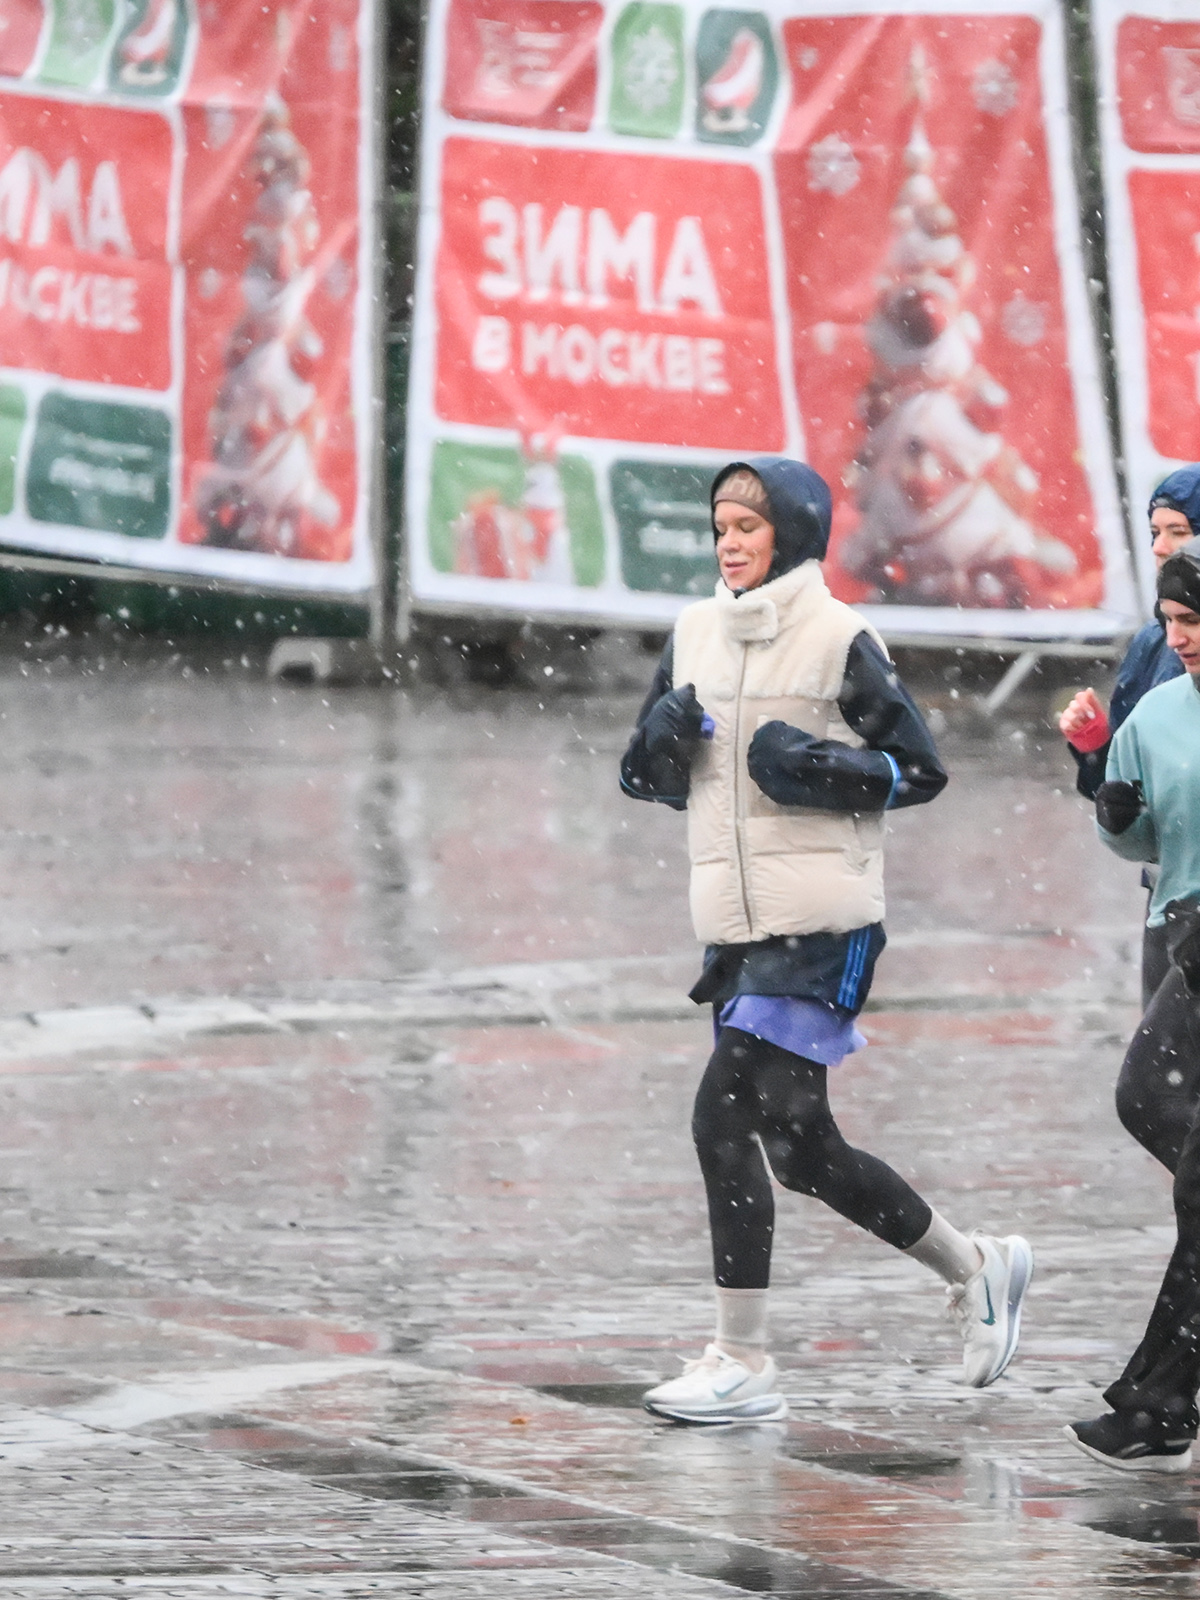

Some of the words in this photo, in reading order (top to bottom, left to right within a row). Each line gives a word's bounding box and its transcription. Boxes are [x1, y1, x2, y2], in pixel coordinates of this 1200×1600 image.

[476, 195, 725, 320] ЗИМА
[472, 315, 511, 374] В
[521, 321, 731, 396] МОСКВЕ
